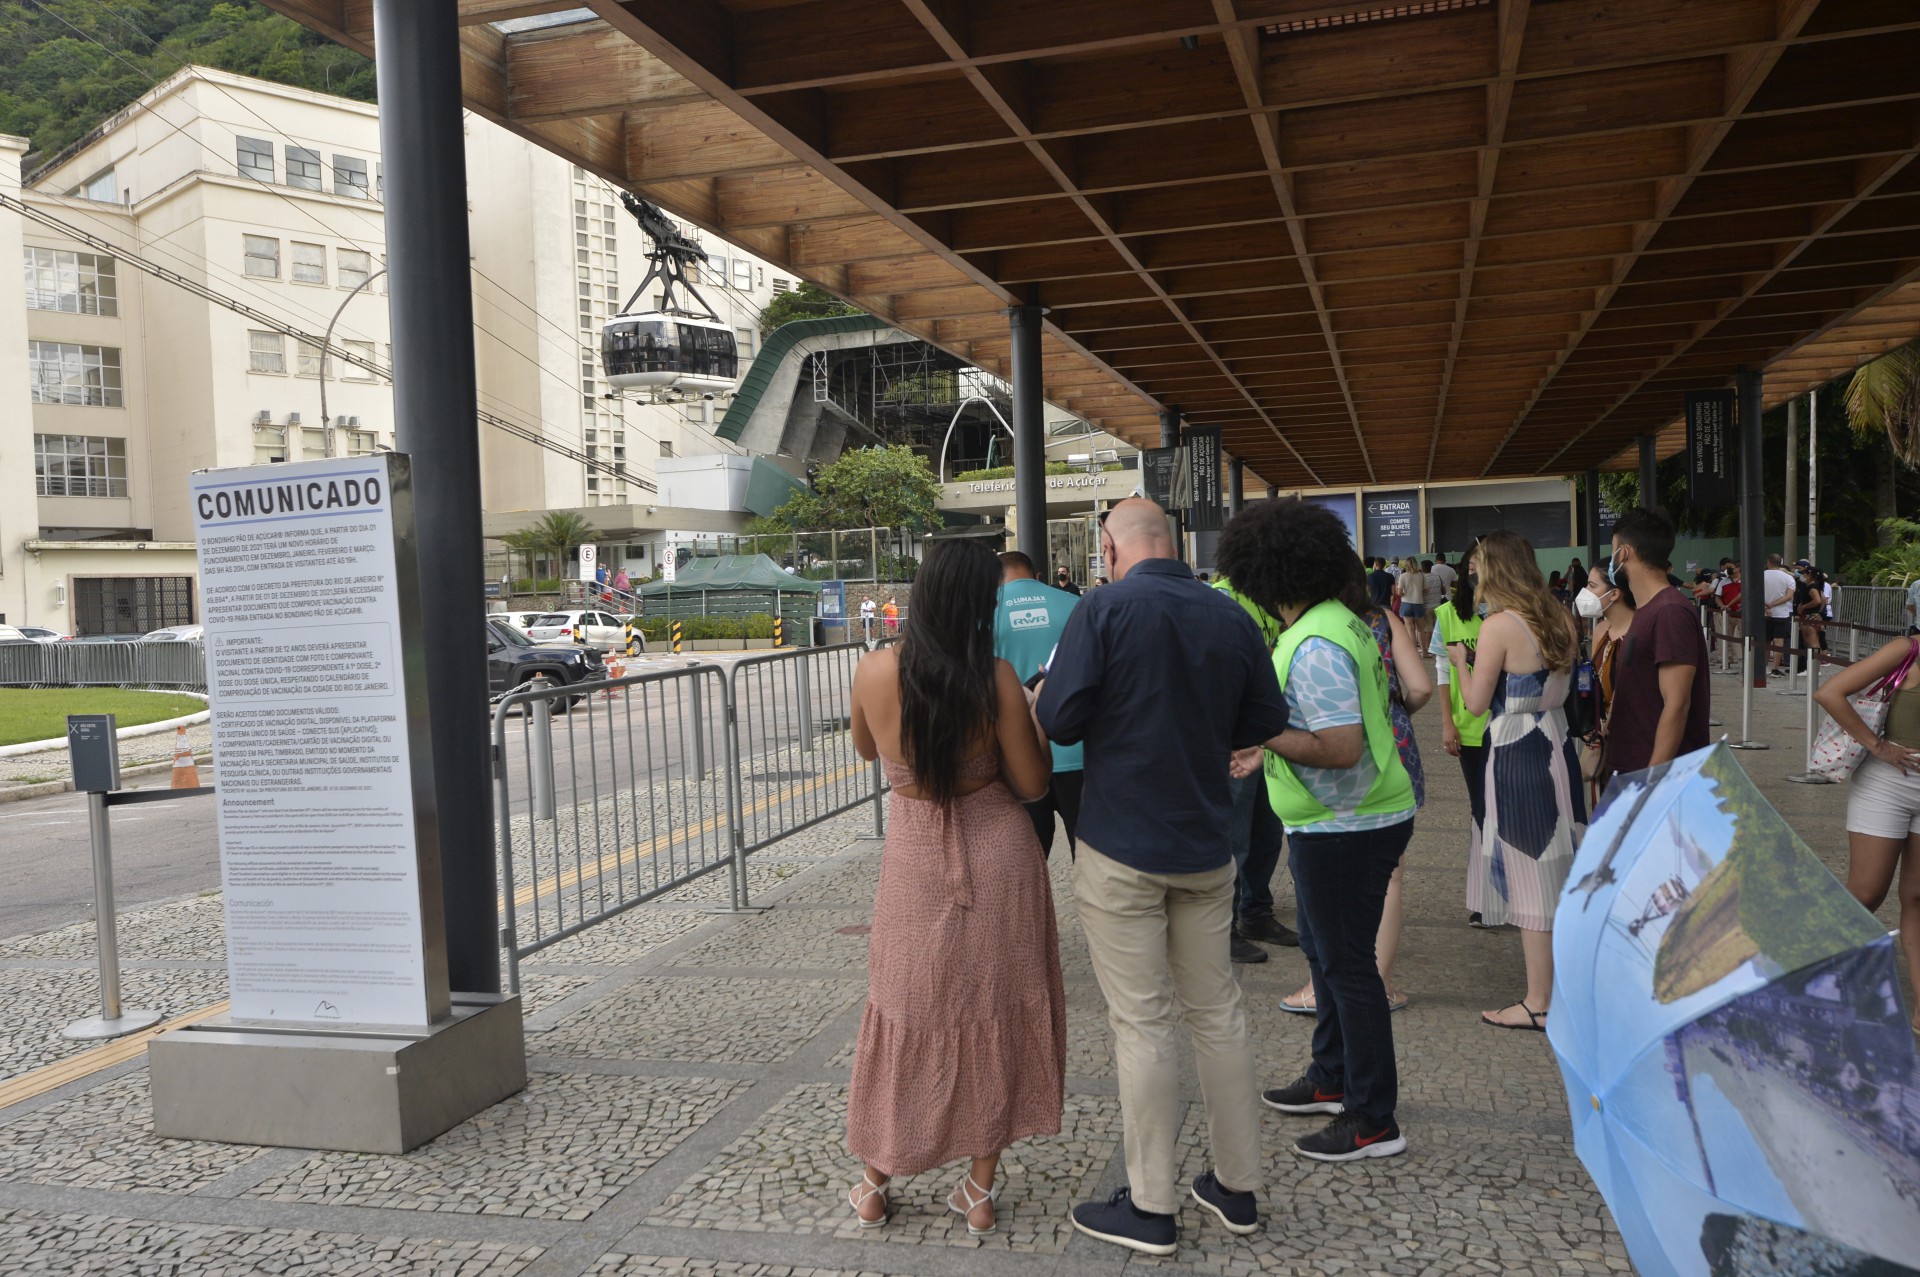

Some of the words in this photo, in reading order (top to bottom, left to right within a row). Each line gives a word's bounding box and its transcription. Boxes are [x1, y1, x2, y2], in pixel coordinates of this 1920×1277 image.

[969, 481, 1015, 493] Teleféric
[1050, 478, 1063, 488] de
[1067, 475, 1107, 489] Açúcar
[198, 477, 380, 520] COMUNICADO
[207, 536, 235, 545] BONDINHO
[284, 529, 310, 538] INFORMA
[329, 526, 349, 534] PARTIR
[212, 546, 240, 554] DEZEMBRO
[264, 541, 277, 550] TERÁ
[305, 536, 329, 546] HORÁRIO
[204, 555, 250, 565] FUNCIONAMENTO
[318, 546, 348, 556] FEVEREIRO
[586, 550, 590, 559] E
[260, 562, 286, 570] ENTRADA
[295, 559, 326, 568] VISITANTES
[215, 586, 237, 594] ACORDO
[257, 582, 282, 591] DECRETO
[291, 579, 324, 588] PREFEITURA
[353, 575, 376, 584] JANEIRO
[280, 591, 310, 599] DEZEMBRO
[349, 584, 384, 594] NECESSÁRIO
[208, 606, 242, 614] APRESENTAR
[243, 603, 278, 612] DOCUMENTO
[291, 600, 321, 608] COMPROVE
[323, 596, 354, 607] VACINAÇÃO
[355, 596, 377, 604] CONTRA
[1013, 595, 1046, 603] LUMAJAX
[208, 616, 234, 624] COVID-19
[284, 610, 313, 619] BONDINHO
[308, 642, 330, 651] DEVERÁ
[331, 641, 367, 650] APRESENTAR
[216, 658, 252, 667] DOCUMENTO
[262, 656, 294, 664] IDENTIDADE
[331, 651, 373, 660] COMPROVANTE
[292, 663, 344, 673] CORRESPONDENTE
[280, 676, 319, 684] RESPEITANDO
[325, 672, 361, 682] CALENDÁRIO
[219, 687, 262, 698] COMPROVAÇÃO
[271, 685, 303, 696] VACINAÇÃO
[216, 710, 234, 718] SERÃO
[265, 718, 296, 728] VACINAÇÃO
[320, 715, 351, 724] DISPONÍVEL
[251, 729, 268, 737] ÚNICO
[278, 728, 296, 736] SAÚDE
[330, 735, 360, 745] VACINAÇÃO
[220, 759, 250, 768] VACINAÇÃO
[304, 766, 342, 776] INSTITUIÇÕES
[222, 798, 275, 807] Announcement
[229, 899, 274, 907] Comunicación
